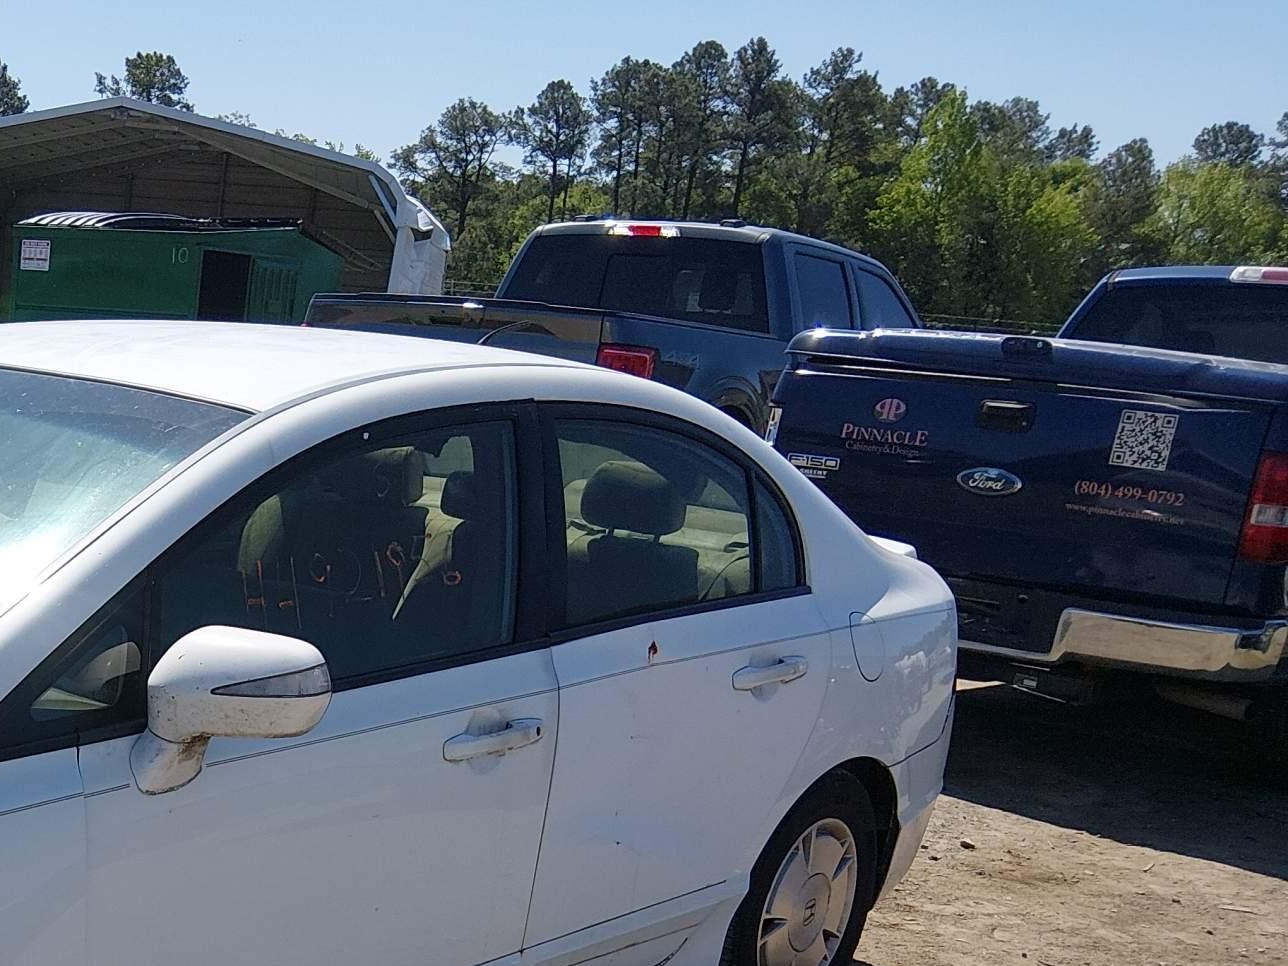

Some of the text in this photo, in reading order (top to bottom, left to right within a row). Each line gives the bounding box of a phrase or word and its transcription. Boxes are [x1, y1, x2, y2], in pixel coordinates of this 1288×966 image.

[172, 247, 189, 265] 10
[840, 423, 929, 447] PINNACLE
[968, 471, 1006, 490] Ford
[1074, 480, 1185, 506] (804) 499-0792
